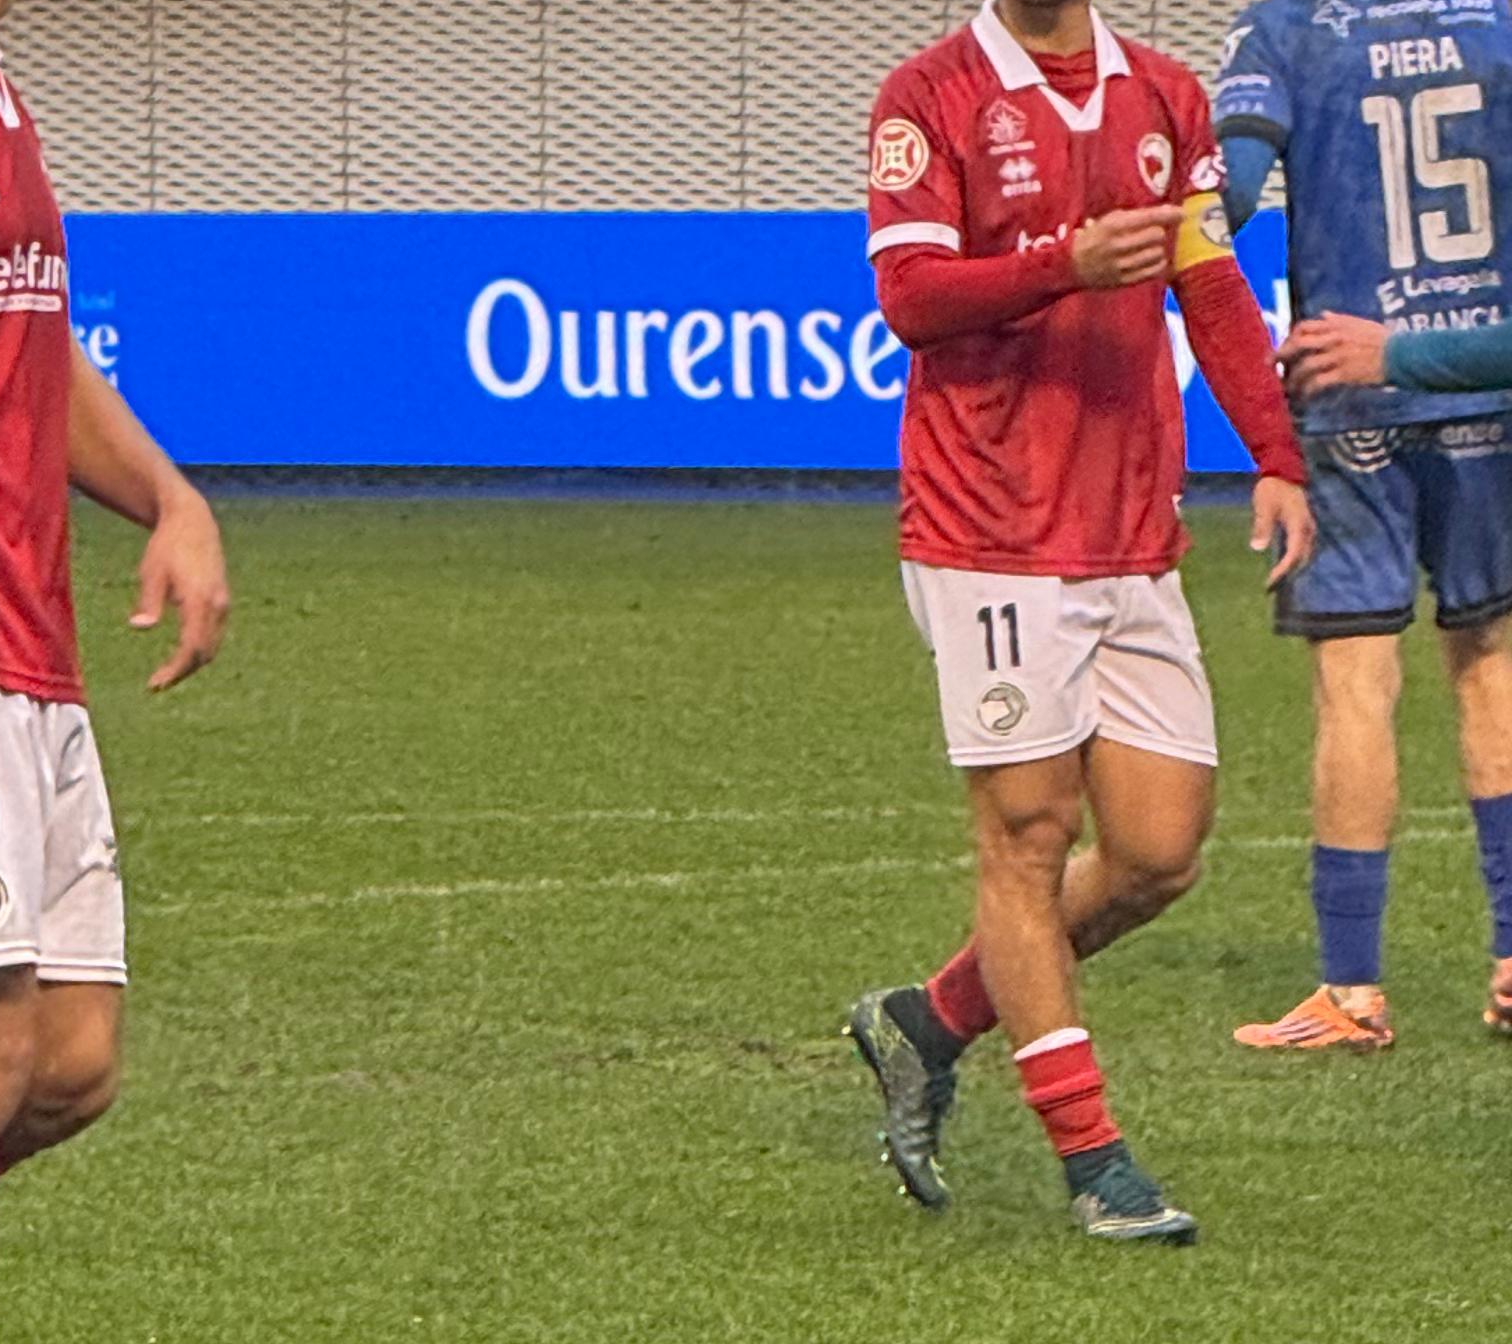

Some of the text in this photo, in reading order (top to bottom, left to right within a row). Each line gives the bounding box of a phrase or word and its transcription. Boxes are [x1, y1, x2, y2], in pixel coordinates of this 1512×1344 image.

[1368, 36, 1463, 80] PIERA
[1361, 83, 1494, 270] 15
[465, 277, 905, 401] Ourense
[976, 602, 1022, 672] 11
